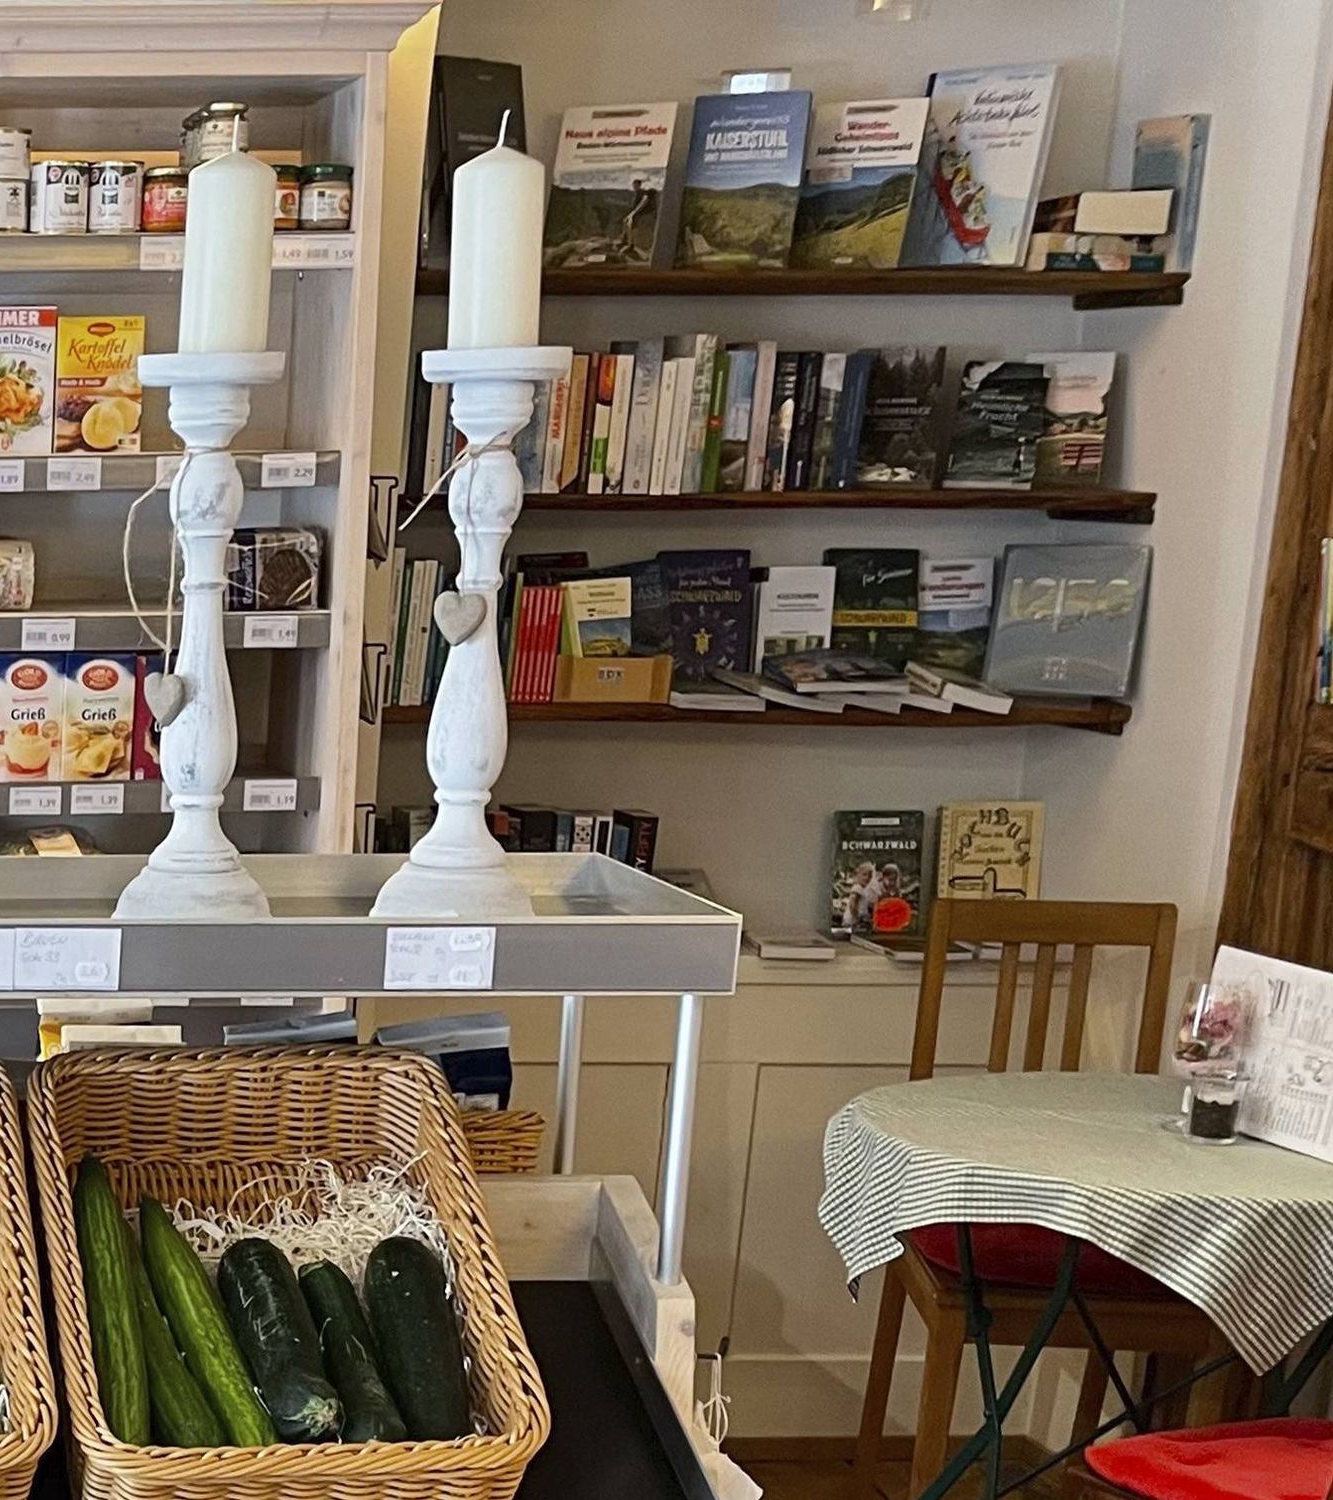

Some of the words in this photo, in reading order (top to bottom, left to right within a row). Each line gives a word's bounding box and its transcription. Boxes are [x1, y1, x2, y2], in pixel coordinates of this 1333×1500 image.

[564, 128, 594, 139] Neue
[596, 127, 631, 139] alpine
[634, 125, 668, 137] Pfade
[847, 120, 891, 131] Wander-
[705, 129, 789, 150] KAISERSTUHL
[335, 248, 355, 260] 1,59
[68, 338, 126, 362] Kartoffel
[86, 353, 133, 372] Knödel
[597, 669, 624, 680] BOX
[11, 708, 46, 721] Grieß
[81, 708, 117, 721] Grieß
[638, 820, 652, 851] FIFTY
[841, 840, 918, 851] SCHWARZWALD
